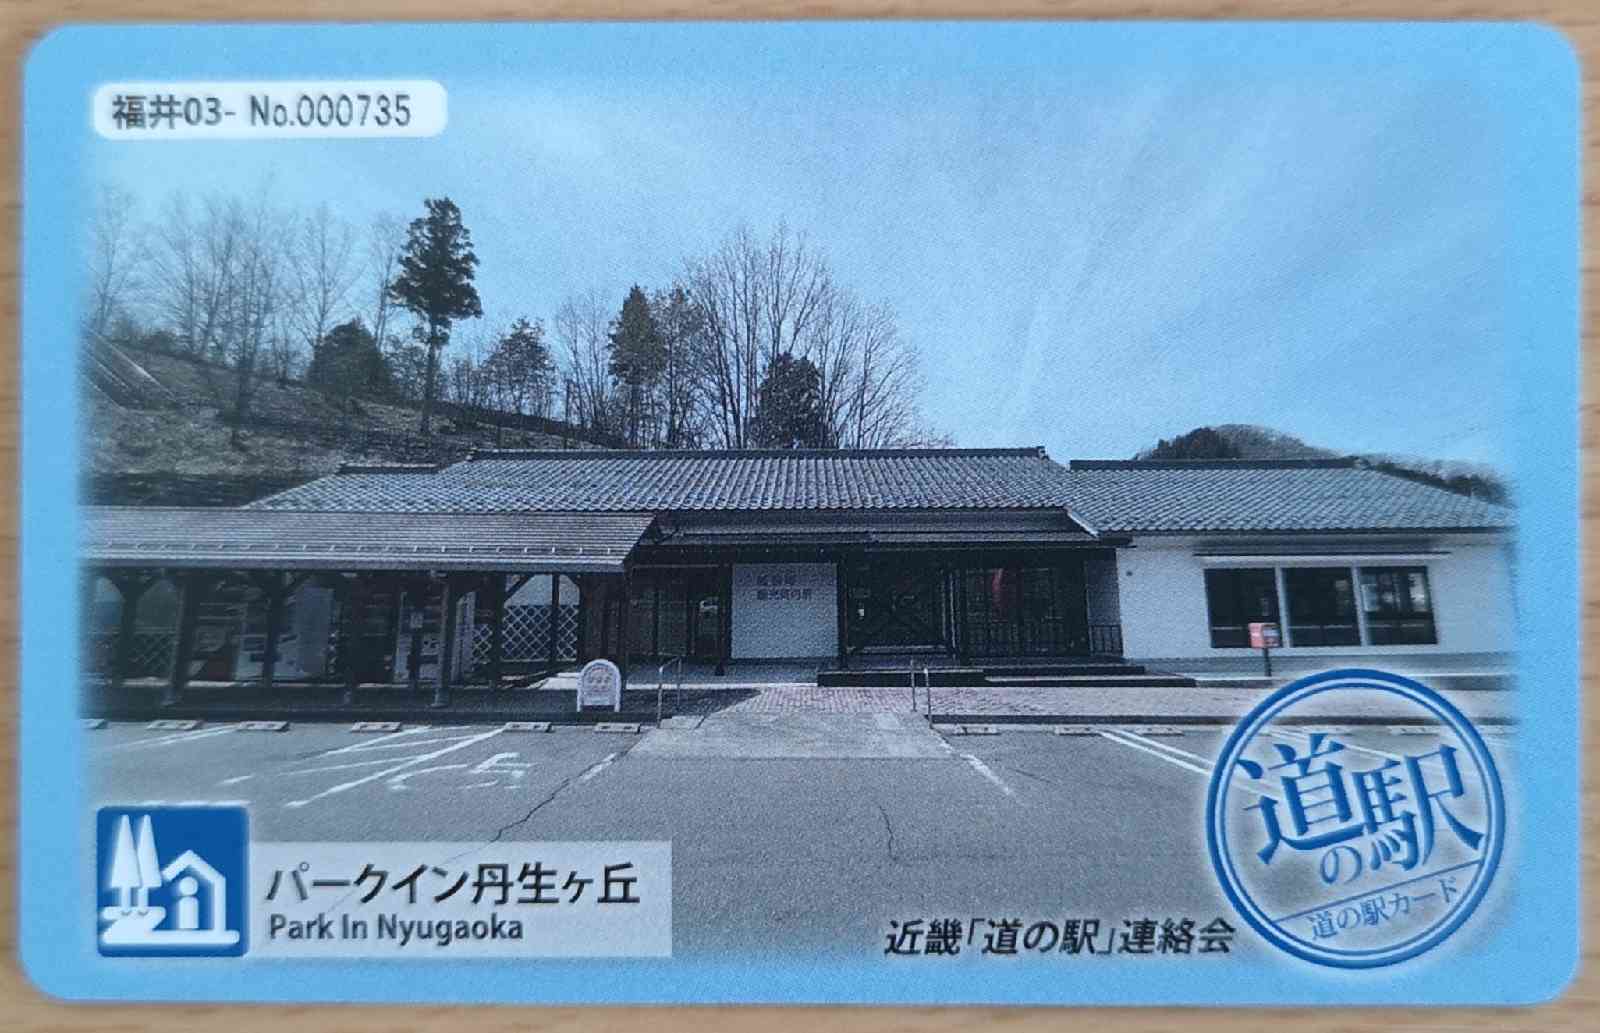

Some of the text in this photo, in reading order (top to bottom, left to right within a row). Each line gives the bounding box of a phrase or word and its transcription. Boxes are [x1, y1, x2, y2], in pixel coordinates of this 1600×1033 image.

[112, 94, 412, 130] 福井03- No.000735
[1236, 733, 1484, 885] 道の駅
[265, 861, 641, 906] パークイン丹生ヶ丘
[1305, 877, 1458, 941] 道の駅カード
[270, 914, 523, 947] Park In Nyugaoka
[884, 917, 1236, 956] 近畿「道の駅」連絡会
